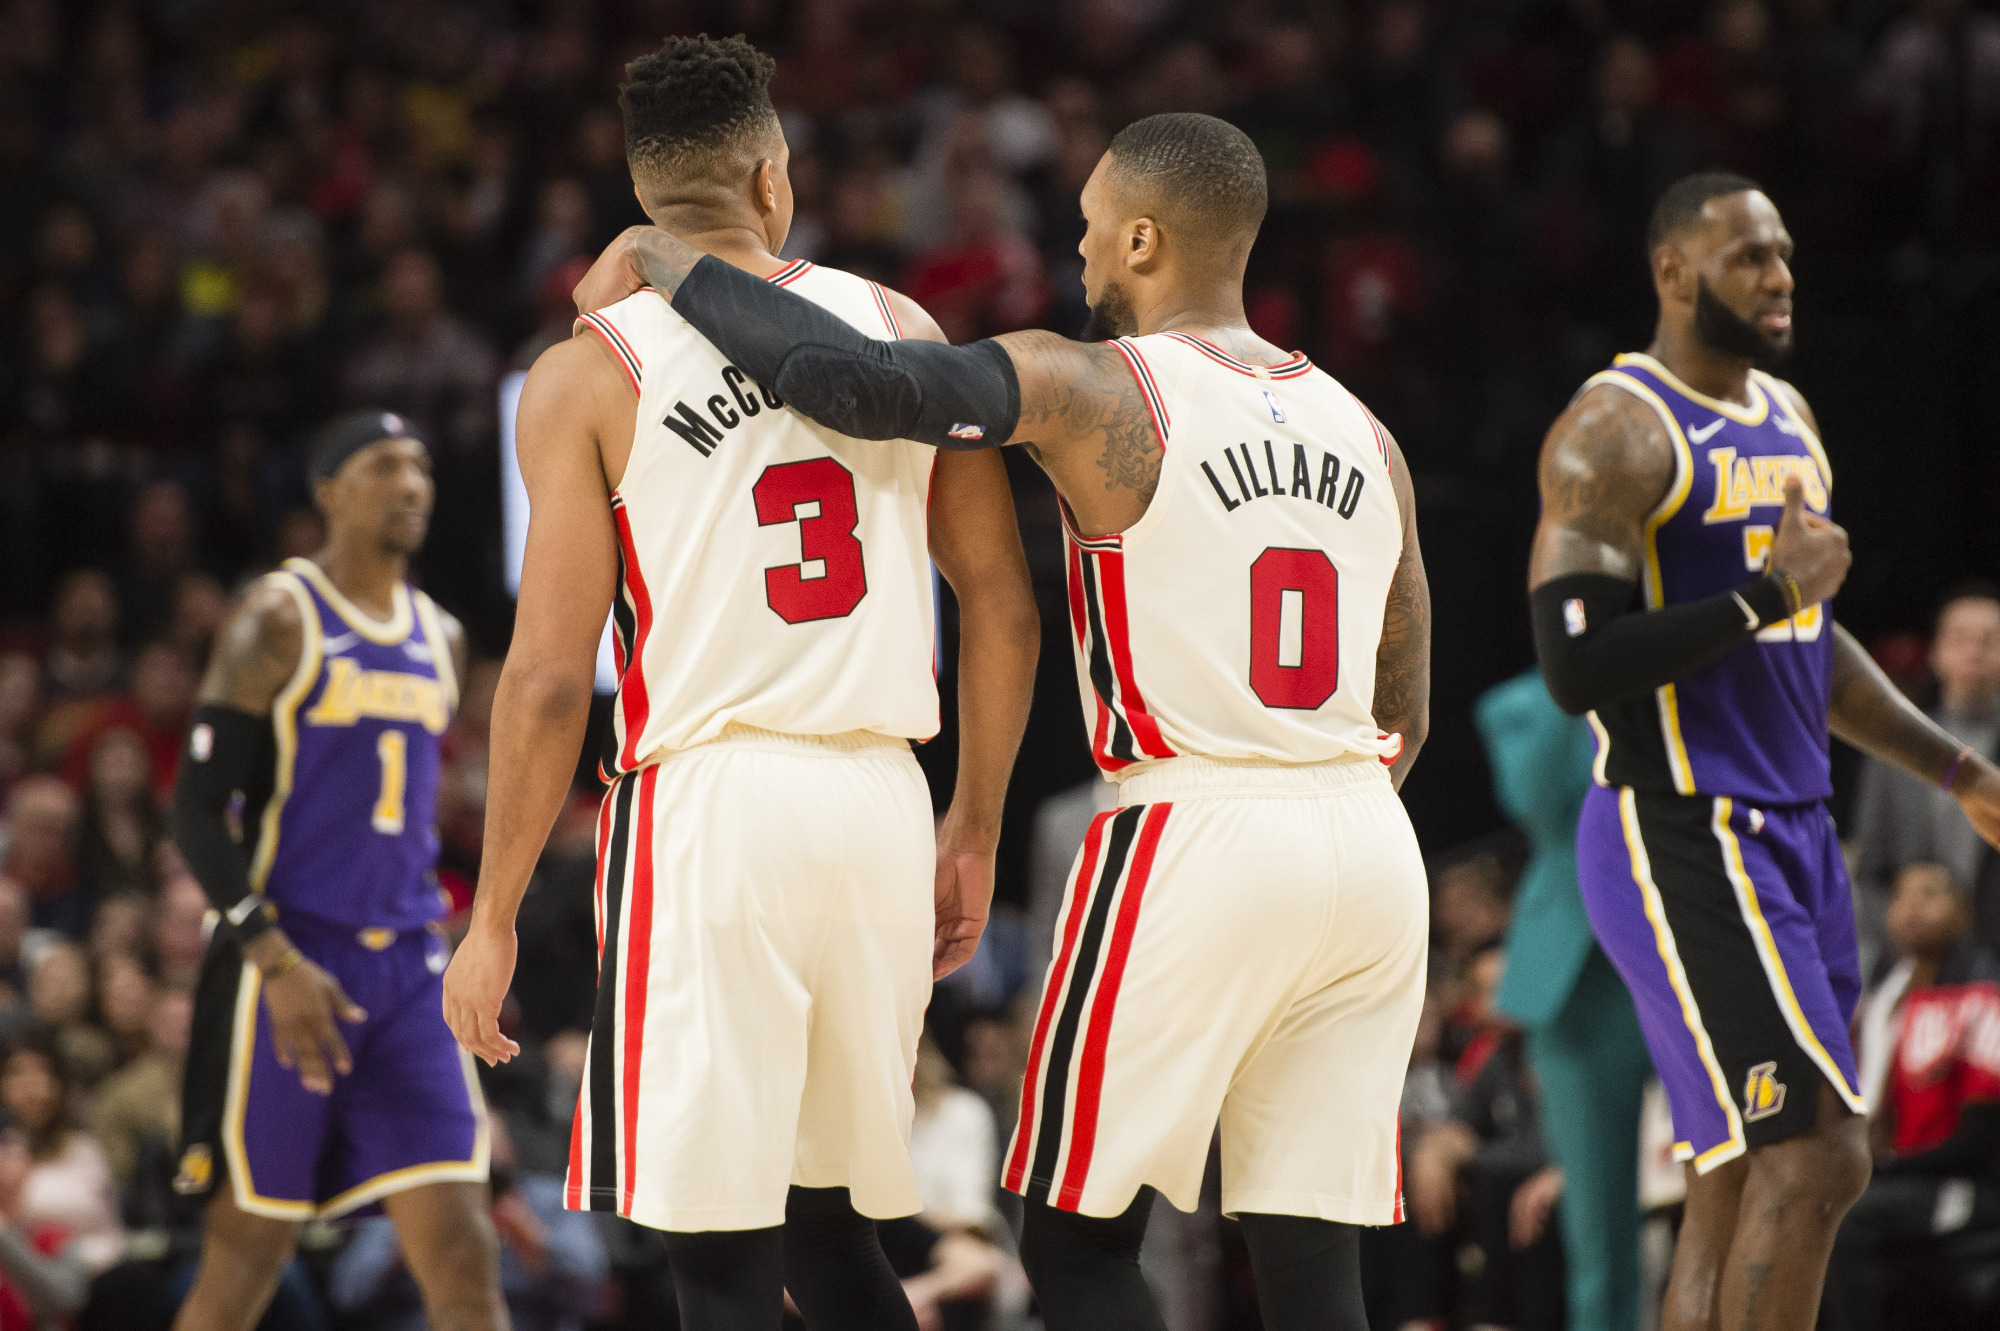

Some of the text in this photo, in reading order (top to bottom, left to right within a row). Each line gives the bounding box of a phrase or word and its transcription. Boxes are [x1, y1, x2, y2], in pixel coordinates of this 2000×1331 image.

[751, 455, 868, 625] 3
[1200, 440, 1365, 520] LILLARD
[1249, 546, 1339, 711] 0
[370, 729, 409, 836] 1
